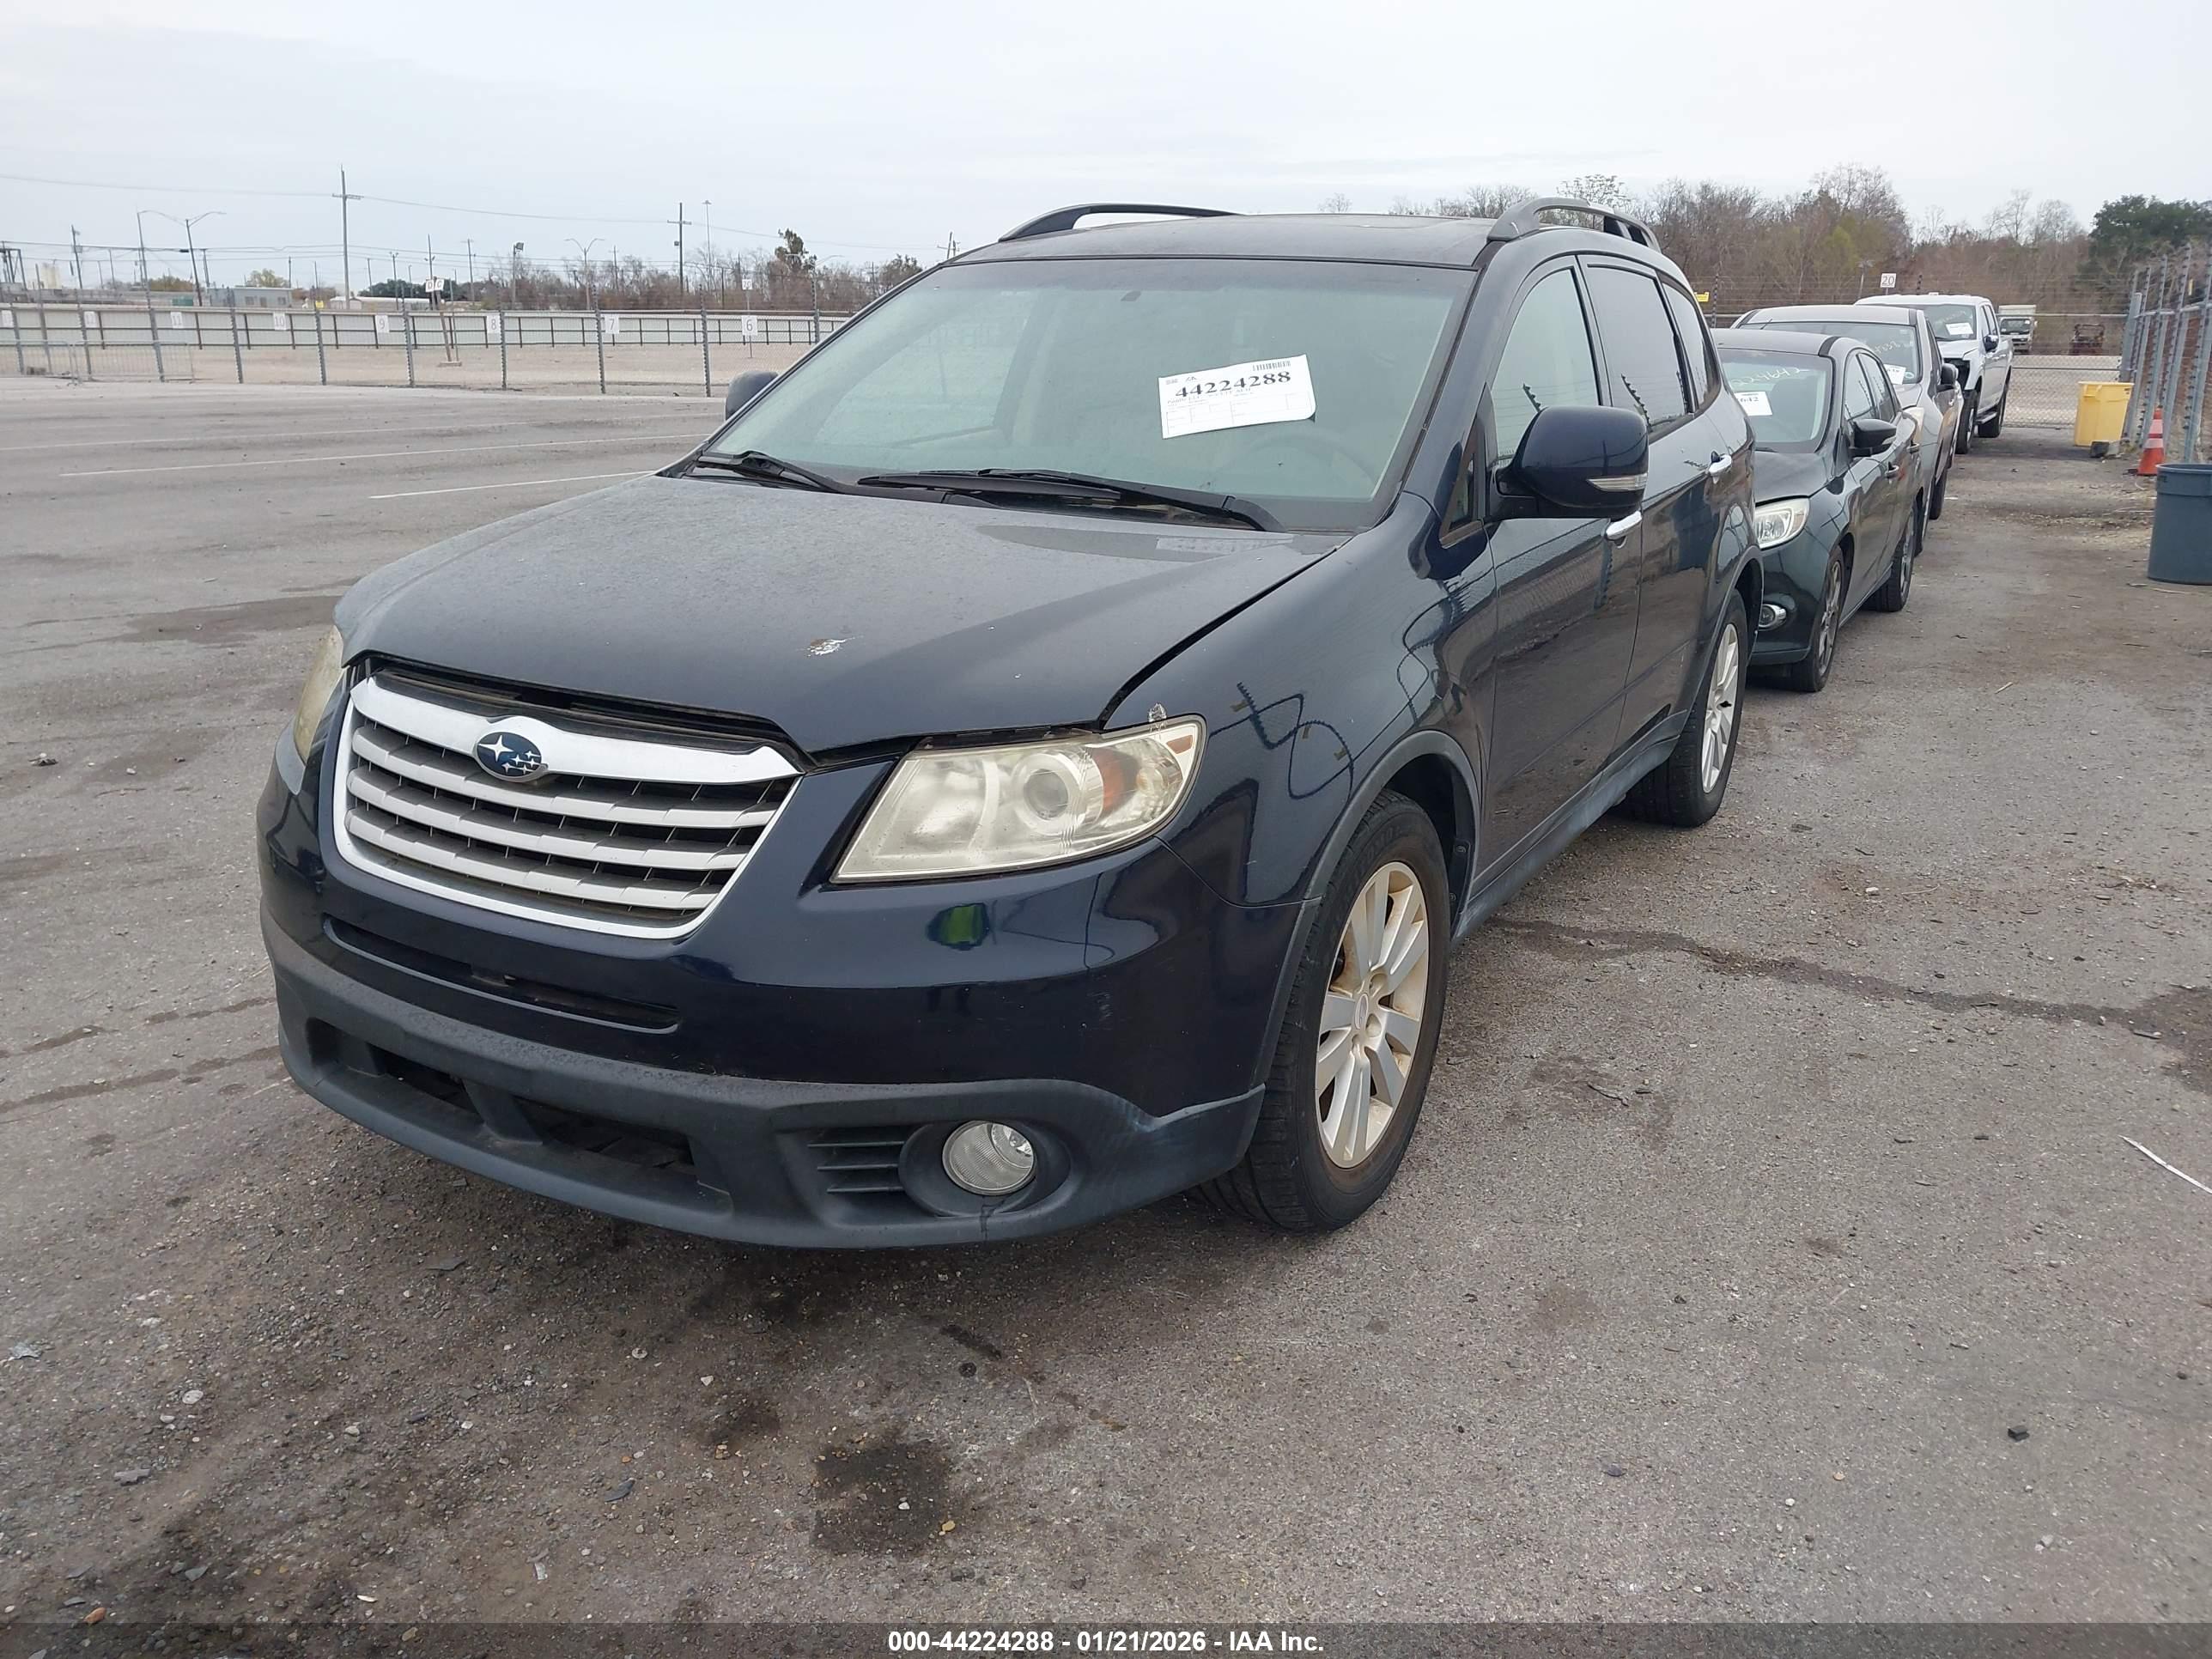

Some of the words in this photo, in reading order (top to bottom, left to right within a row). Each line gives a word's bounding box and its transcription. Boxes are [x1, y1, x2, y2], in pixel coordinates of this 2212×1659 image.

[1882, 276, 1894, 285] 20
[275, 317, 284, 327] 10
[380, 319, 386, 330] 9
[490, 319, 497, 330] 8
[609, 319, 615, 331] 7
[746, 319, 752, 331] 6
[1176, 371, 1291, 398] 44224288
